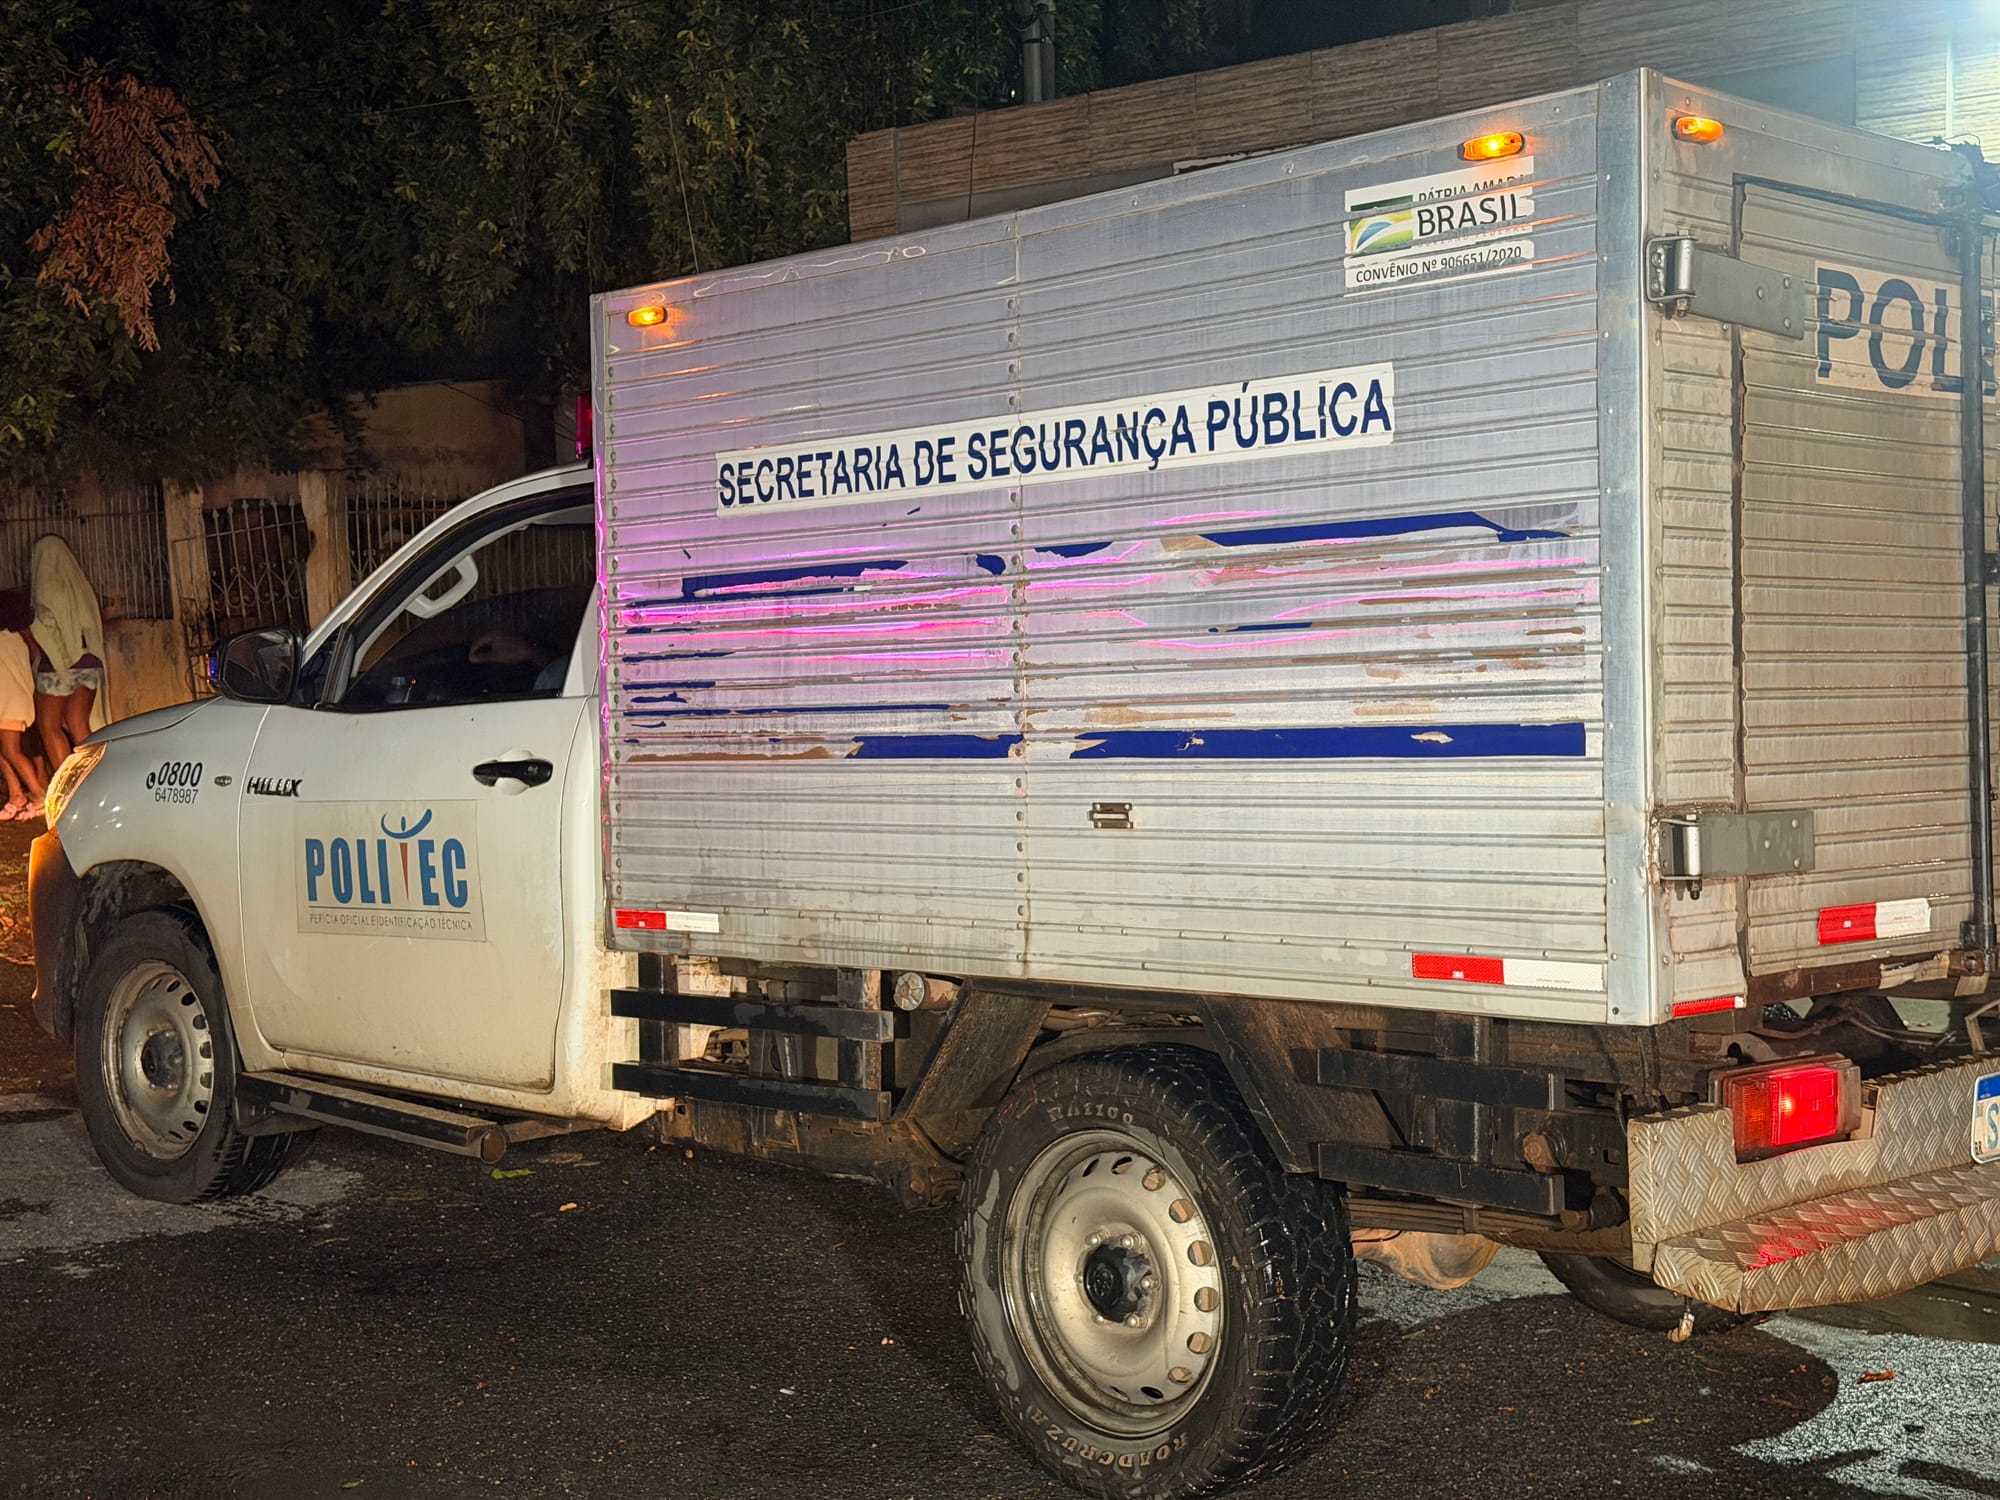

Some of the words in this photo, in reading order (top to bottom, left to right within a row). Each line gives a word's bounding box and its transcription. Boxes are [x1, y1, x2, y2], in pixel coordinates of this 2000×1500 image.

[1417, 193, 1528, 237] BRASIL
[1355, 259, 1418, 283] CONVÊNIO
[1440, 246, 1522, 270] 906651/2020
[719, 443, 906, 507] SECRETARIA
[914, 436, 956, 486] DE
[967, 404, 1197, 481] SEGURANÇA
[1206, 379, 1392, 451] PÚBLICA
[157, 761, 203, 787] 0800
[246, 776, 303, 797] HILUX
[154, 787, 199, 804] 6478987
[305, 809, 468, 908] POLITEC
[309, 912, 338, 925] PERÍCIA
[341, 914, 371, 927] OFICIAL
[377, 915, 436, 930] IDENTIFICAÇÃO
[438, 917, 473, 931] TÉCNICA
